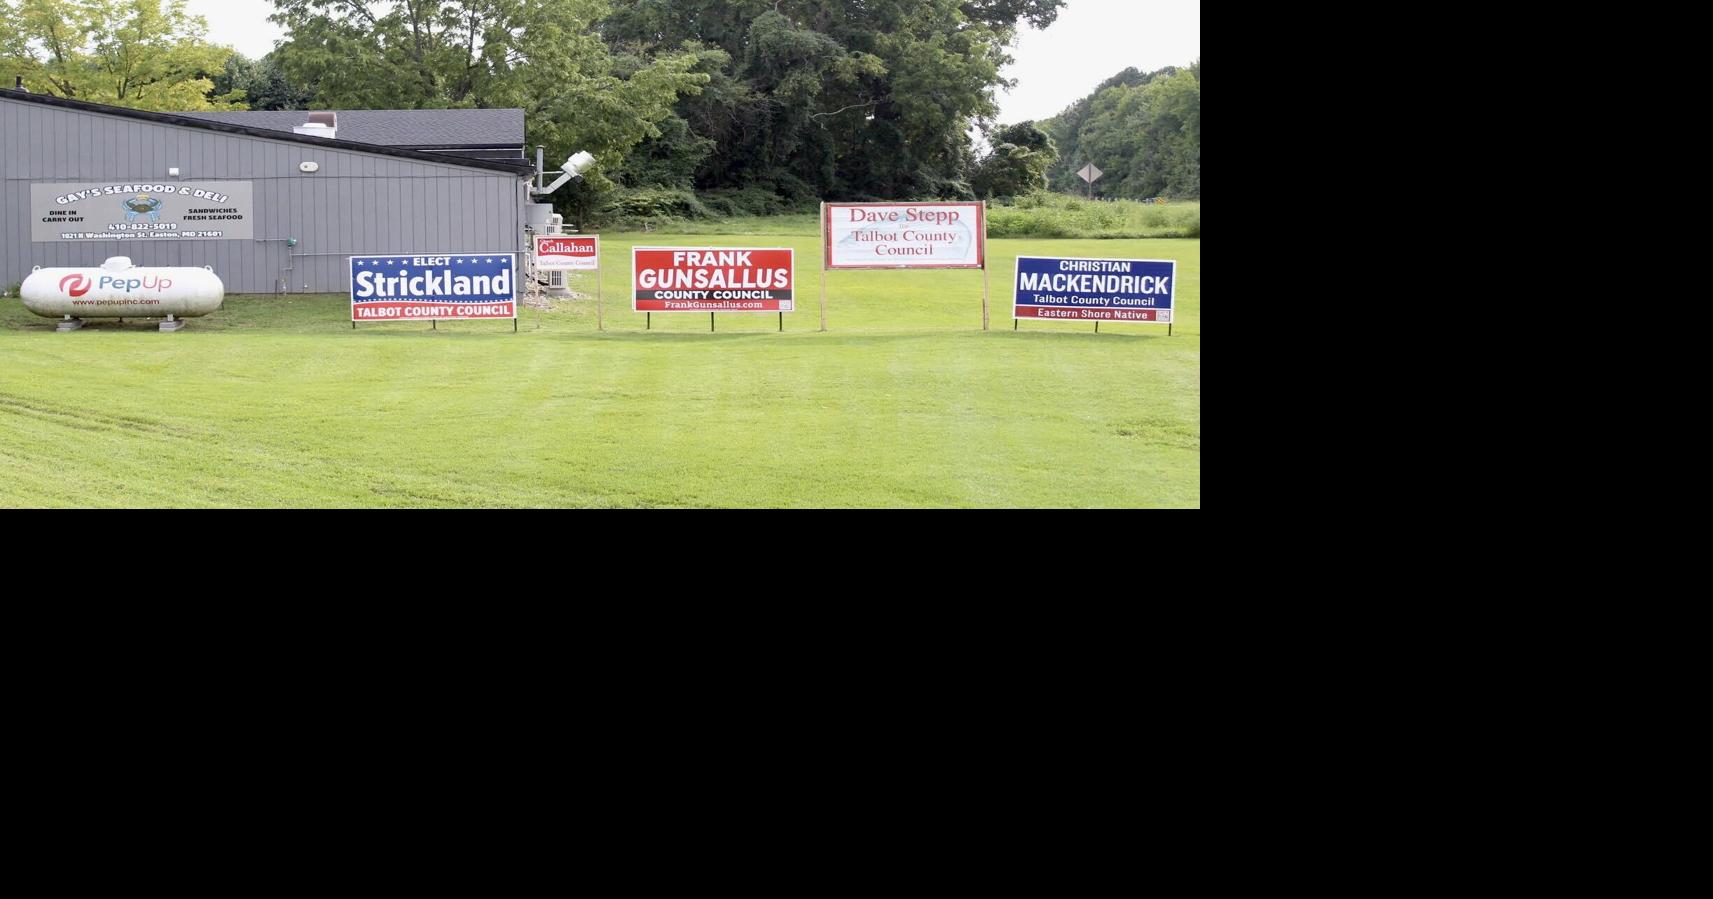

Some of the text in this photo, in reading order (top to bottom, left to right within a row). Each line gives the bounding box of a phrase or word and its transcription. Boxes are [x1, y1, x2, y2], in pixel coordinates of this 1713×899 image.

[56, 185, 228, 205] GAY'S SEAFOOD & DELI
[850, 208, 959, 225] Dave Stepp
[85, 232, 135, 240] Washington
[852, 231, 956, 244] Talbot County
[539, 242, 593, 252] Callahan
[875, 245, 932, 255] Council
[413, 257, 451, 266] ELECT
[674, 252, 752, 266] FRANK
[1060, 261, 1130, 272] CHRISTIAN
[99, 275, 172, 292] PepUp
[356, 269, 510, 297] Strickland
[639, 268, 788, 289] GUNSALLUS
[1020, 273, 1168, 294] MACKENDRICK
[655, 291, 773, 299] COUNTY COUNCIL
[1033, 294, 1154, 306] Talbot County Council
[357, 305, 510, 317] TALBOT COUNTY COUNCIL
[1038, 308, 1147, 319] Eastern Shore Native
